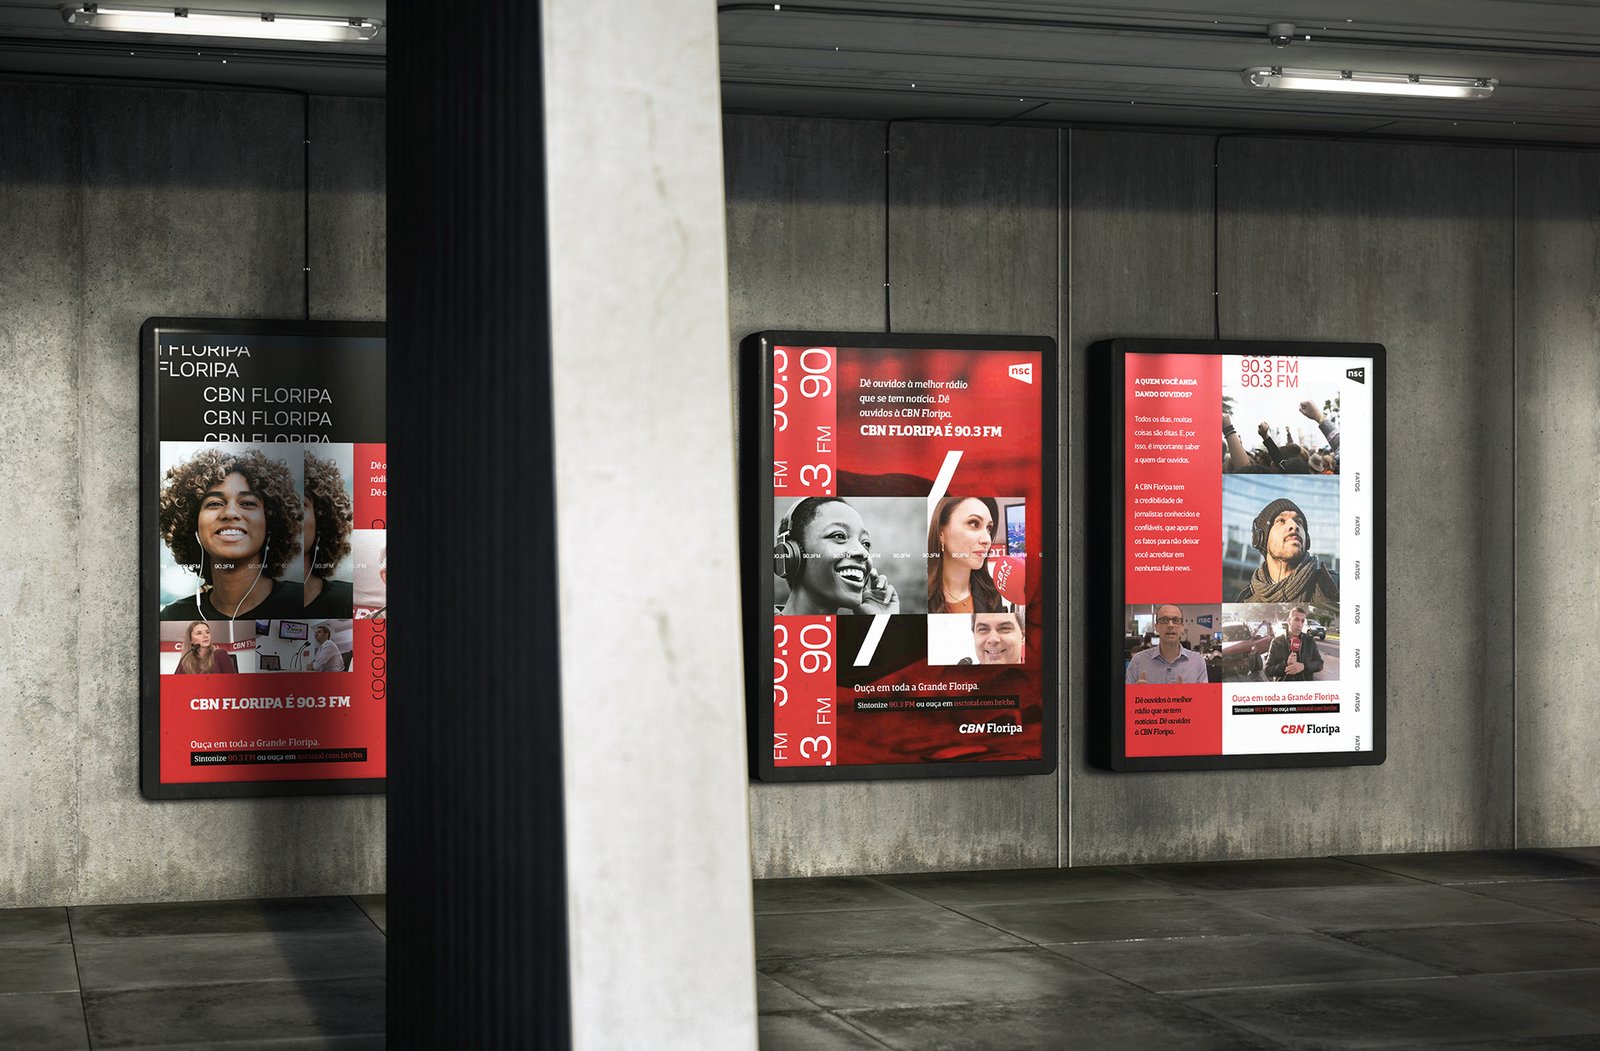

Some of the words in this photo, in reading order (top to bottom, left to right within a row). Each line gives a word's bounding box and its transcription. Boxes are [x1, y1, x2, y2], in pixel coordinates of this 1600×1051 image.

[1011, 367, 1030, 376] nsc
[1241, 360, 1273, 373] 90.3
[1276, 360, 1299, 373] FM
[800, 348, 832, 398] 90
[859, 378, 871, 388] Dê
[872, 379, 906, 389] ouvidos
[908, 380, 913, 389] à
[914, 380, 945, 389] melhor
[945, 380, 968, 390] rádio
[1161, 377, 1178, 385] VOCÊ
[1241, 374, 1273, 388] 90.3
[1276, 375, 1299, 388] FM
[203, 386, 245, 403] CBN
[252, 387, 332, 404] FLORIPA
[859, 395, 876, 404] que
[888, 395, 905, 403] tem
[906, 394, 936, 404] notícia.
[938, 394, 950, 404] Dê
[203, 410, 245, 426] CBN
[252, 410, 332, 426] FLORIPA
[859, 408, 893, 417] ouvidos
[894, 409, 900, 418] à
[901, 409, 920, 418] CBN
[921, 408, 952, 420] Floripa.
[860, 425, 887, 436] CBN
[889, 425, 941, 437] FLORIPA
[944, 423, 953, 437] É
[954, 426, 982, 437] 90.3
[983, 426, 1002, 437] FM
[817, 426, 832, 453] FM
[1153, 443, 1184, 451] importante
[1153, 483, 1173, 491] Floripa
[997, 560, 1009, 590] CBN
[1001, 565, 1012, 592] Floripa
[800, 616, 832, 674] 90.
[854, 683, 875, 694] Ouça
[892, 683, 910, 692] toda
[918, 682, 948, 691] Grande
[949, 682, 980, 692] Floripa.
[190, 698, 219, 710] CBN
[222, 697, 284, 709] FLORIPA
[285, 693, 294, 708] É
[297, 696, 326, 708] 90.3
[329, 696, 351, 708] FM
[1143, 696, 1166, 704] ouvidos
[1232, 694, 1250, 704] Ouça
[1264, 694, 1280, 702] toda
[1287, 693, 1313, 701] Grande
[1314, 693, 1340, 702] Floripa.
[817, 698, 832, 724] FM
[857, 701, 888, 709] Sintonize
[959, 723, 985, 734] CBN
[986, 723, 1023, 735] Floripa
[1153, 728, 1175, 736] Floripa.
[1281, 724, 1305, 734] CBN
[1307, 724, 1340, 735] Floripa
[190, 740, 212, 750] Ouça
[229, 740, 248, 748] toda
[256, 739, 286, 747] Grande
[288, 738, 320, 748] Floripa.
[267, 754, 284, 762] ouça
